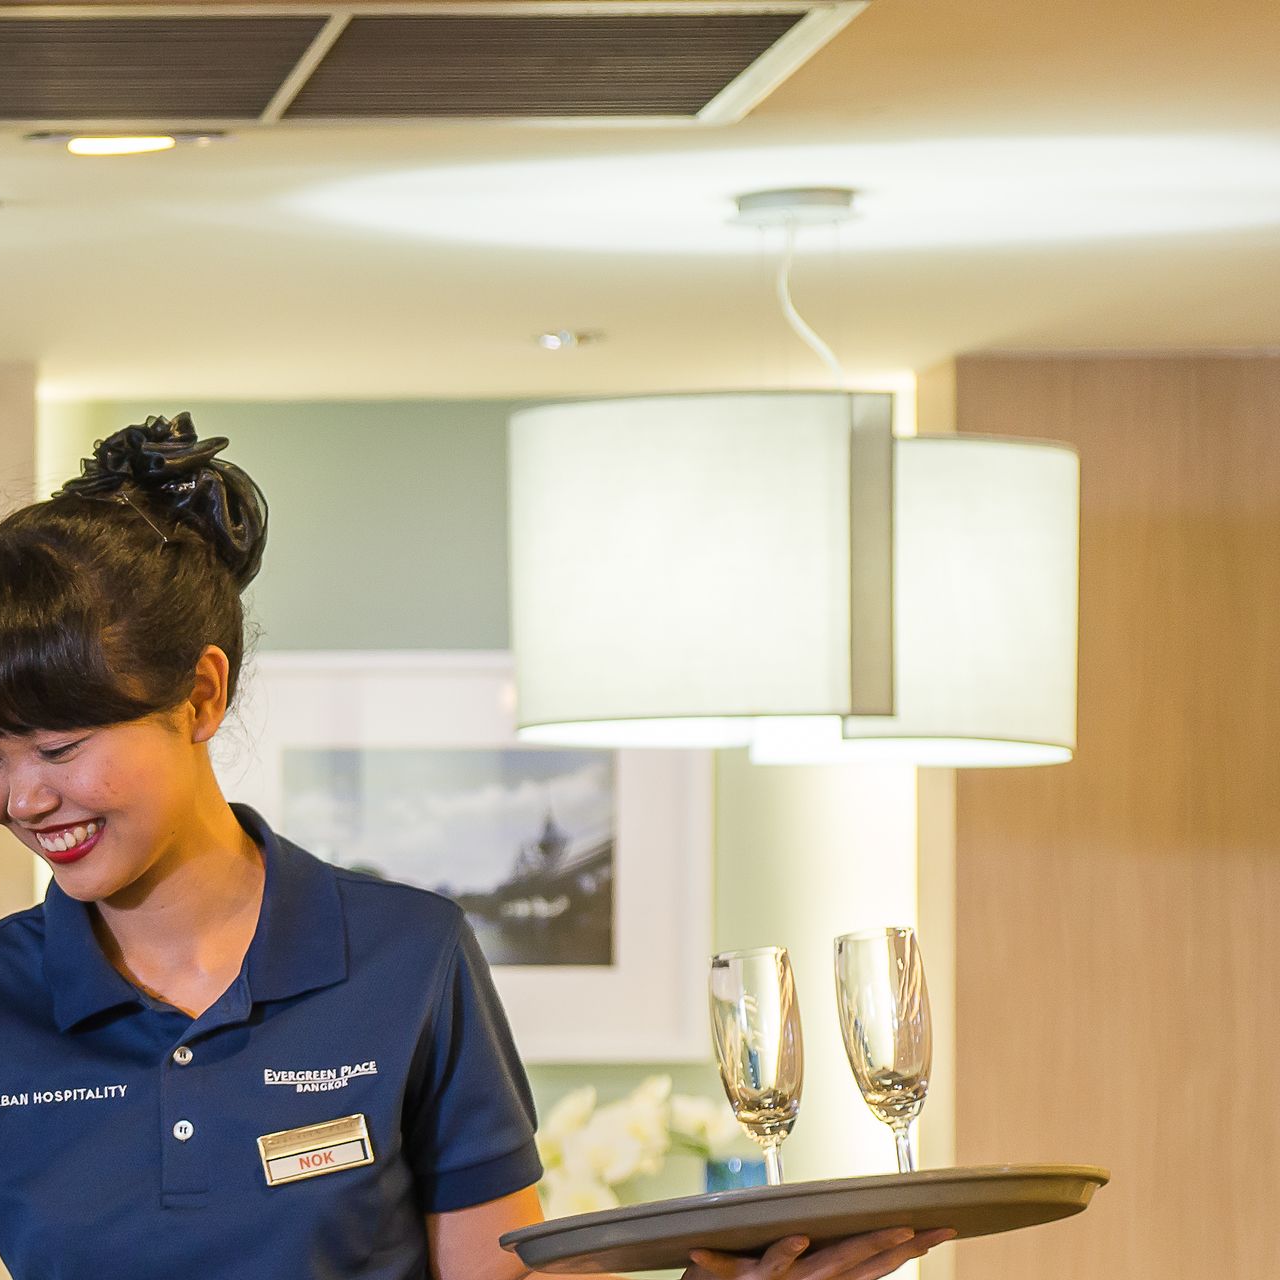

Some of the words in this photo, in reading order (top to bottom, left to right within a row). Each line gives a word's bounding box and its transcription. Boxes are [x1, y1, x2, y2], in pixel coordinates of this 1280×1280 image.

[263, 1068, 337, 1082] EVERGREEN
[341, 1060, 378, 1077] PLACE
[33, 1084, 128, 1103] HOSPITALITY
[296, 1078, 349, 1093] BANGKOK
[299, 1150, 336, 1170] NOK
